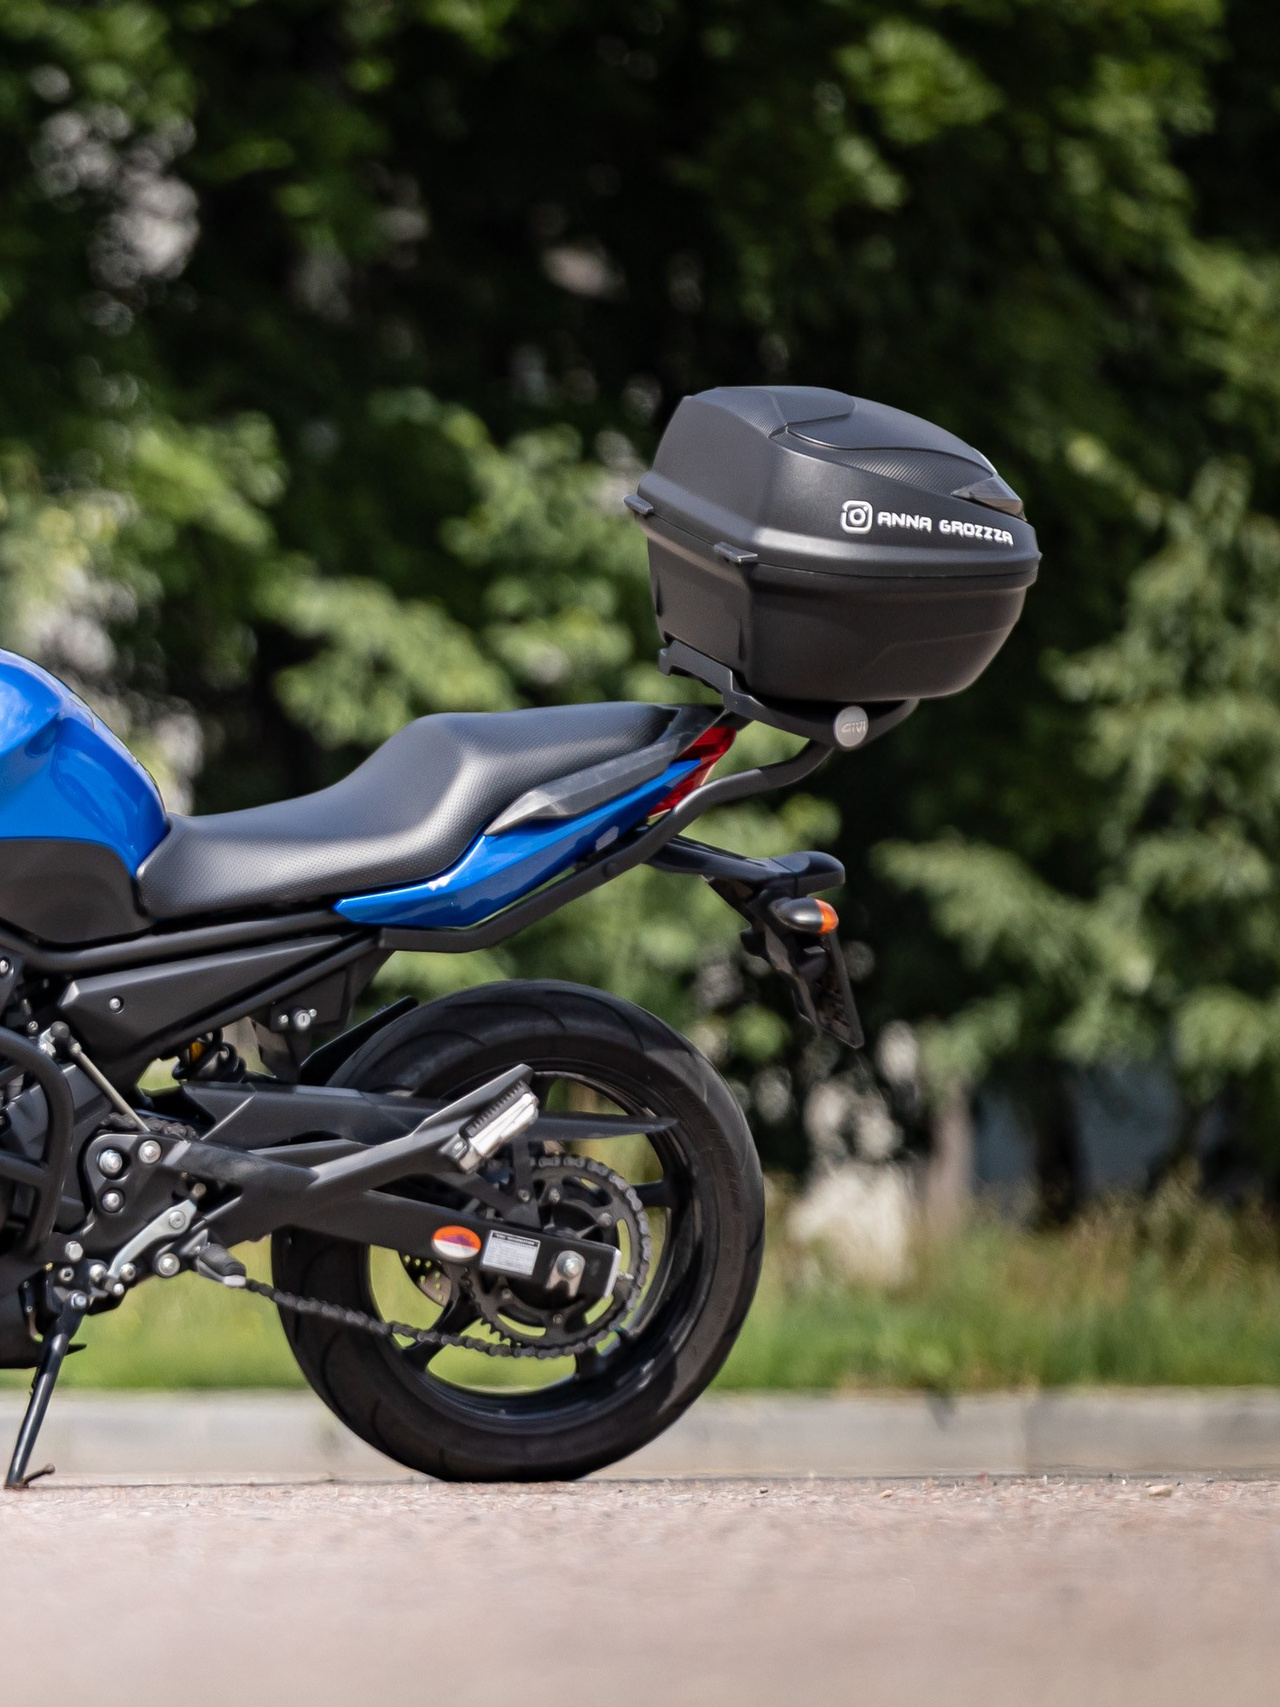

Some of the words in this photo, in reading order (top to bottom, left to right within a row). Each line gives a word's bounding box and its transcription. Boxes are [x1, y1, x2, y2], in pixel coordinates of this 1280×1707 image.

[877, 511, 932, 534] ANNA
[938, 519, 1014, 547] GROZZZA
[841, 720, 866, 733] GIVI
